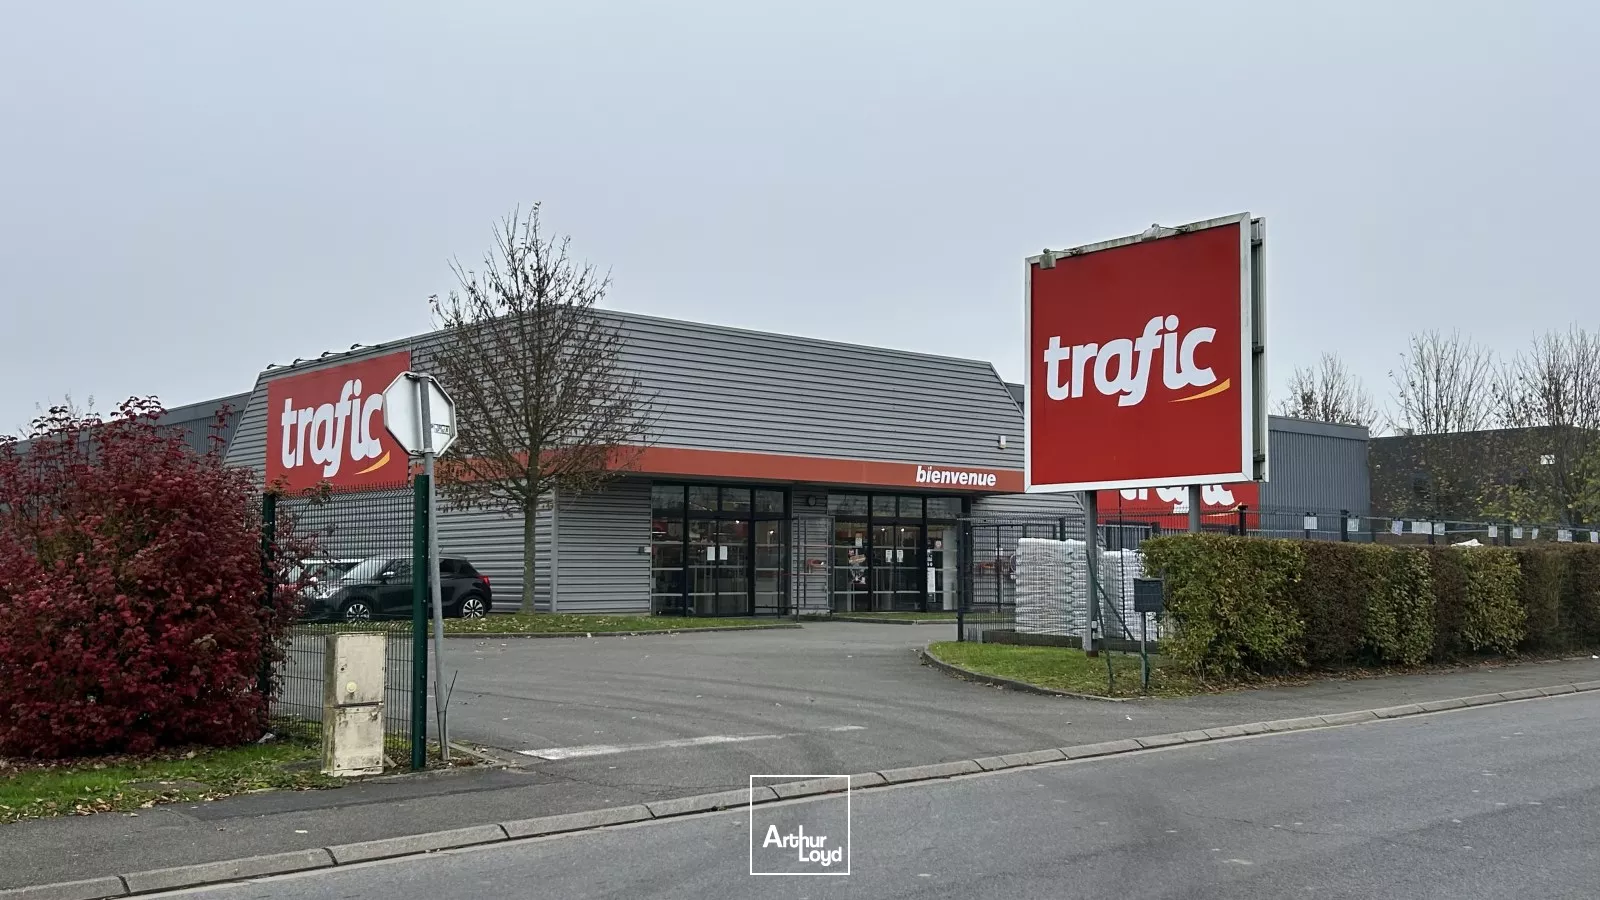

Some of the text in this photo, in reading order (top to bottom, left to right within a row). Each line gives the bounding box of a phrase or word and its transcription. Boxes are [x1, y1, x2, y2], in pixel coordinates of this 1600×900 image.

[1044, 315, 1217, 407] trafic
[281, 379, 383, 478] trafic
[915, 465, 997, 487] bienvenue
